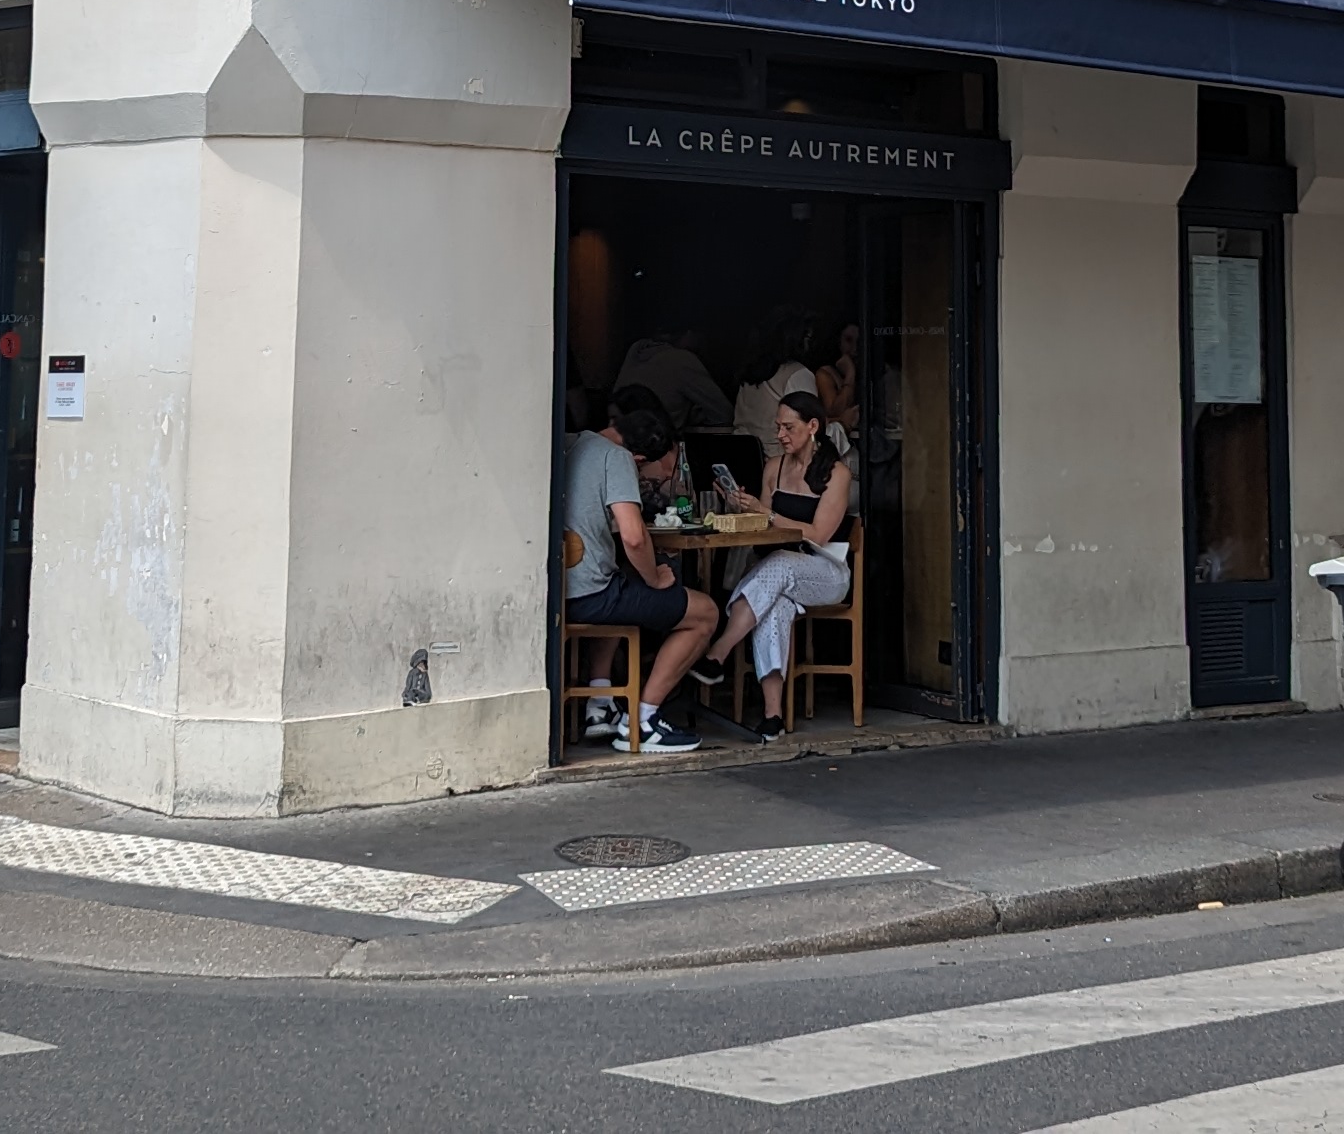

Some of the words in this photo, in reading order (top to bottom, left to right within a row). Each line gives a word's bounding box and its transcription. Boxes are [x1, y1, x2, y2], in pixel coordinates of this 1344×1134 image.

[628, 126, 662, 147] LA
[678, 129, 774, 156] CRÊPE
[788, 139, 955, 170] AUTREMENT
